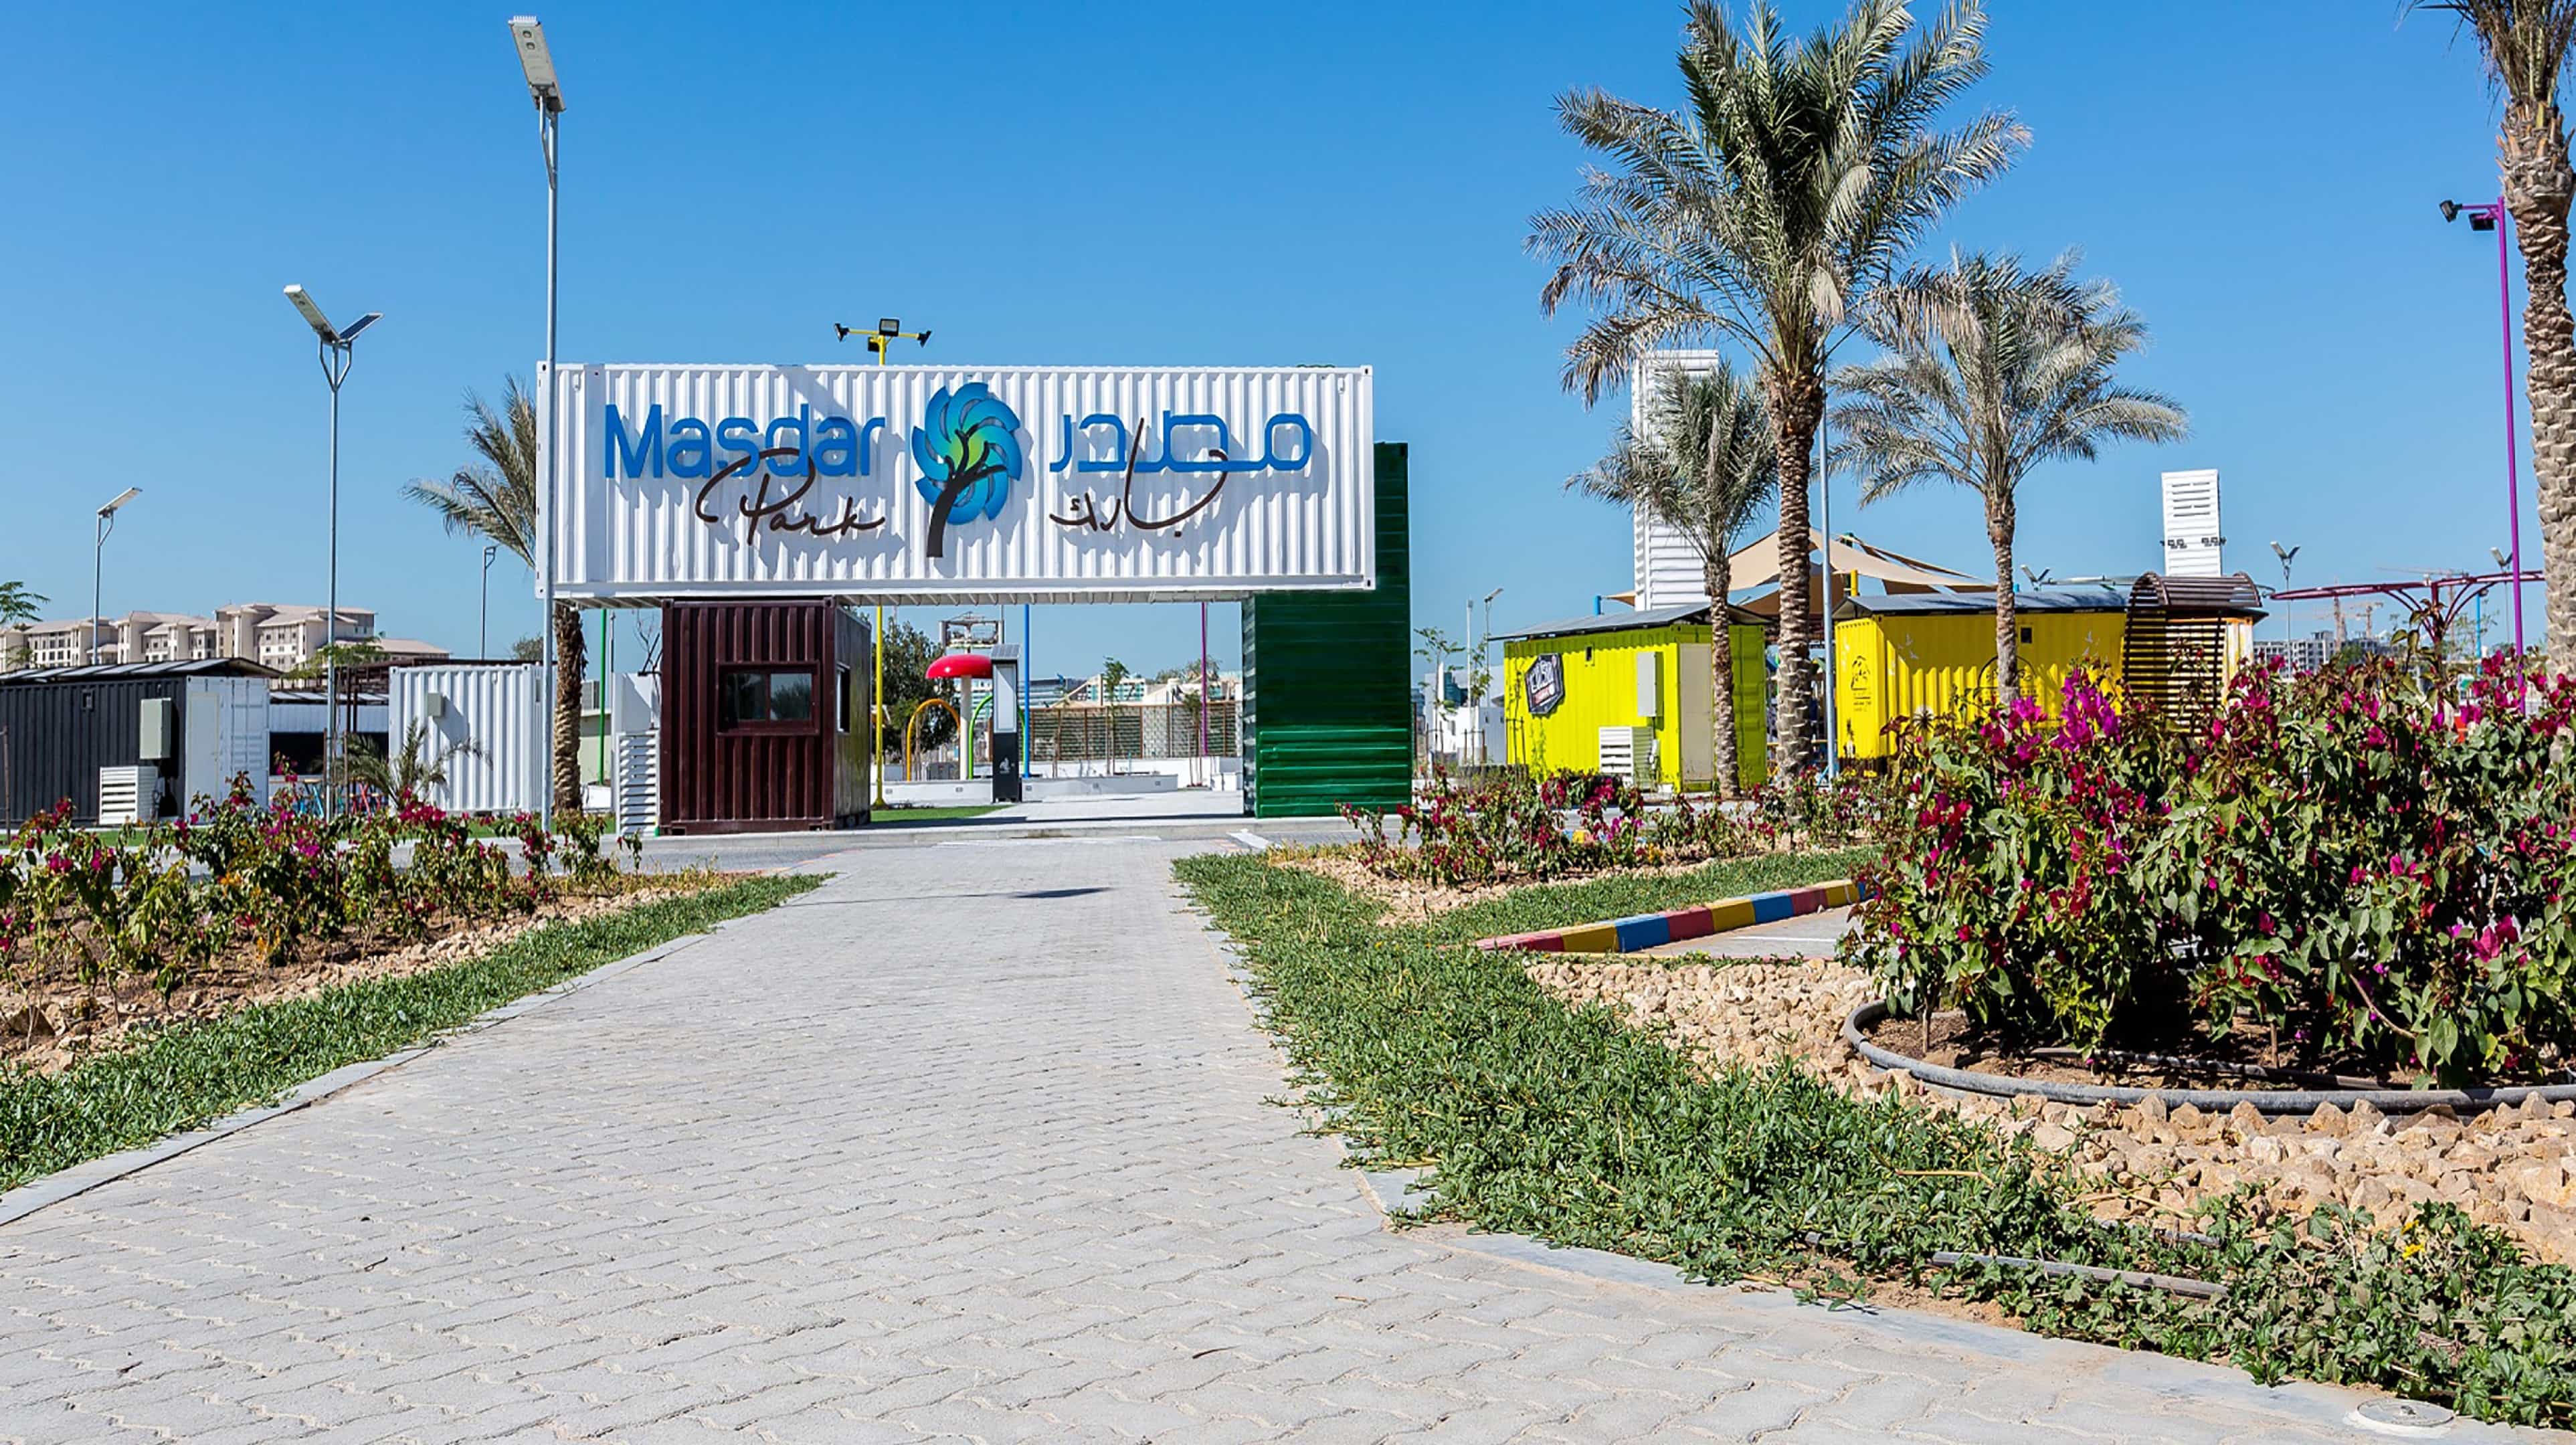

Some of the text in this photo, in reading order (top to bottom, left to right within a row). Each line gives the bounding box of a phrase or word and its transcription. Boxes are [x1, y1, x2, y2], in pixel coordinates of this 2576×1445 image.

[605, 403, 886, 479] Masdar
[1048, 417, 1229, 538] بارك
[1049, 410, 1312, 474] مصدر
[695, 447, 886, 546] Park
